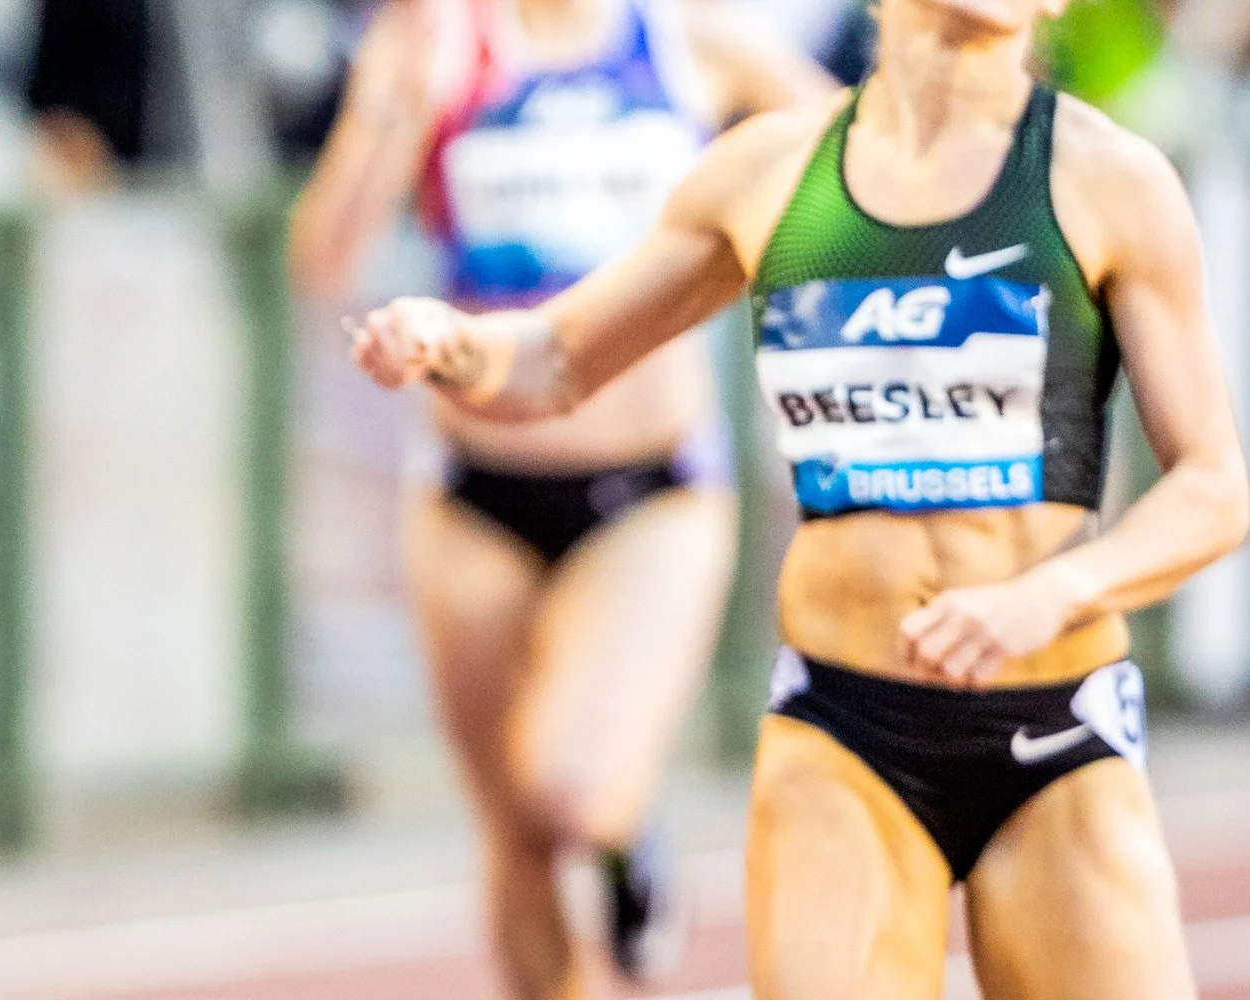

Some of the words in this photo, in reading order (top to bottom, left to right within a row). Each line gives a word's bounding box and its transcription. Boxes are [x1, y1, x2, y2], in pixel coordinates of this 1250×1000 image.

[840, 286, 950, 343] AG
[776, 380, 1018, 428] BEESLEY
[846, 462, 1034, 503] BRUSSELS
